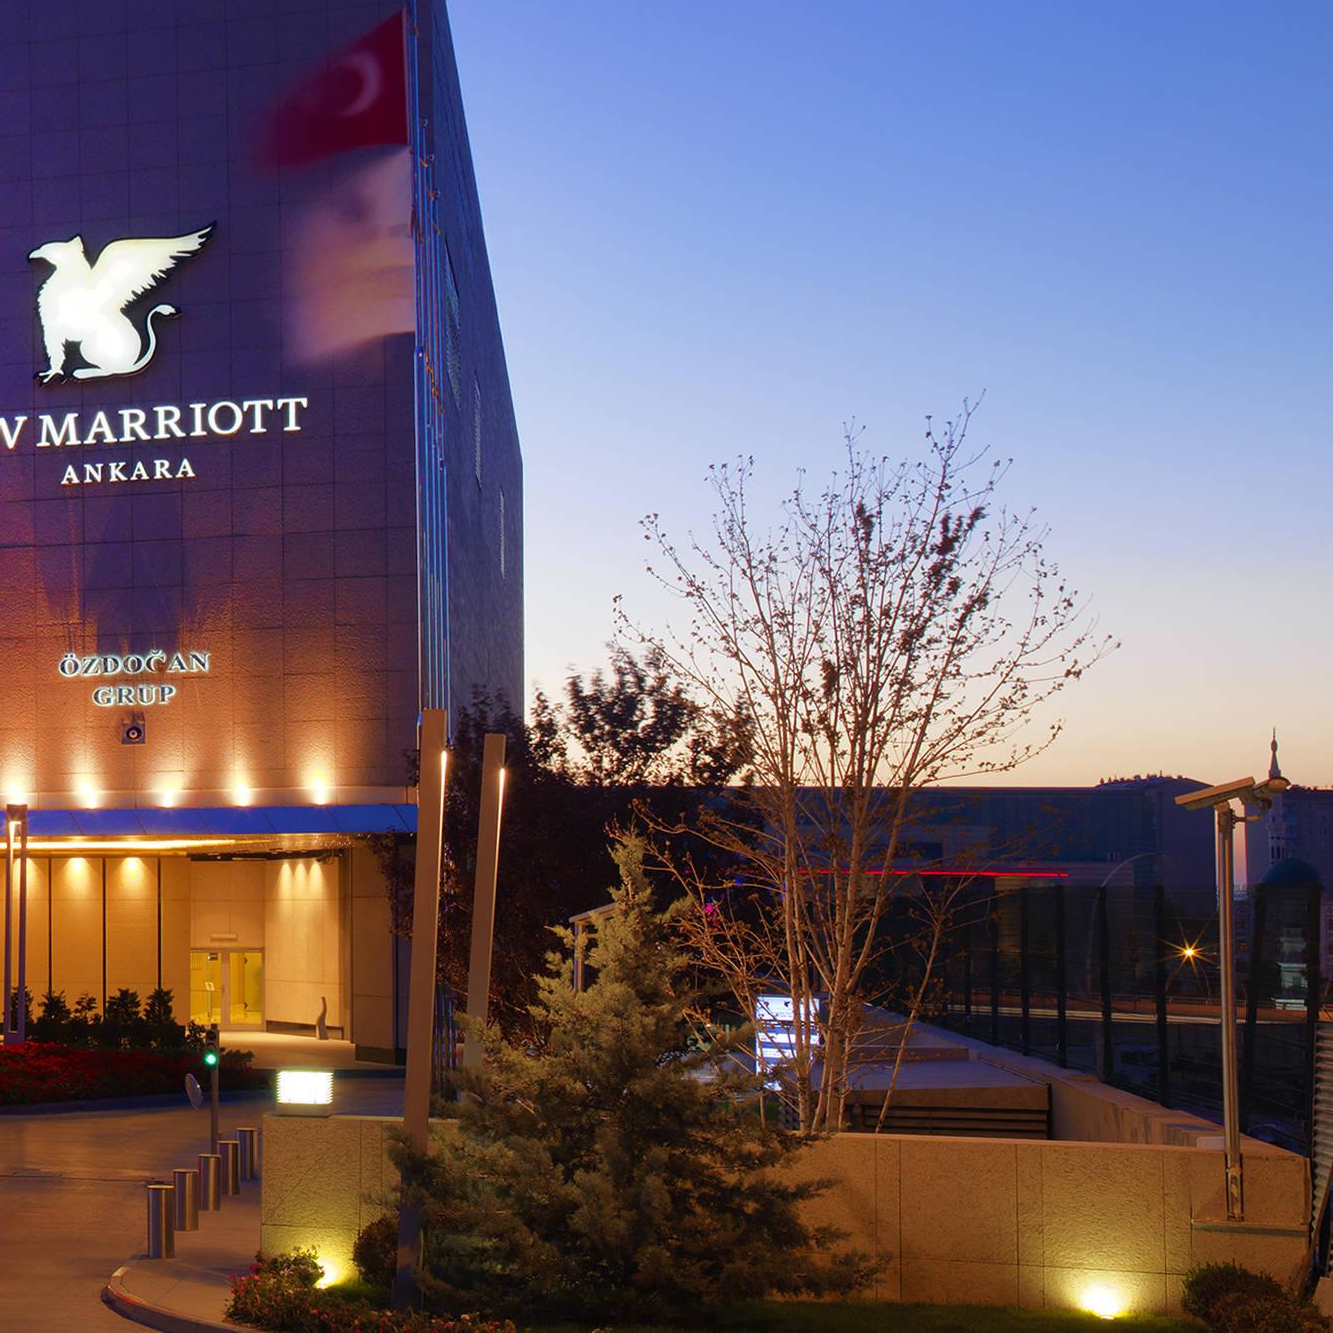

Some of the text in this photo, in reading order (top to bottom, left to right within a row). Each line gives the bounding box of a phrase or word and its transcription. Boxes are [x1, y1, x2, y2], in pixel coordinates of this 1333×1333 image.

[36, 397, 309, 448] MARRIOTT
[60, 458, 196, 486] ANKARA
[92, 684, 177, 707] GRUP
